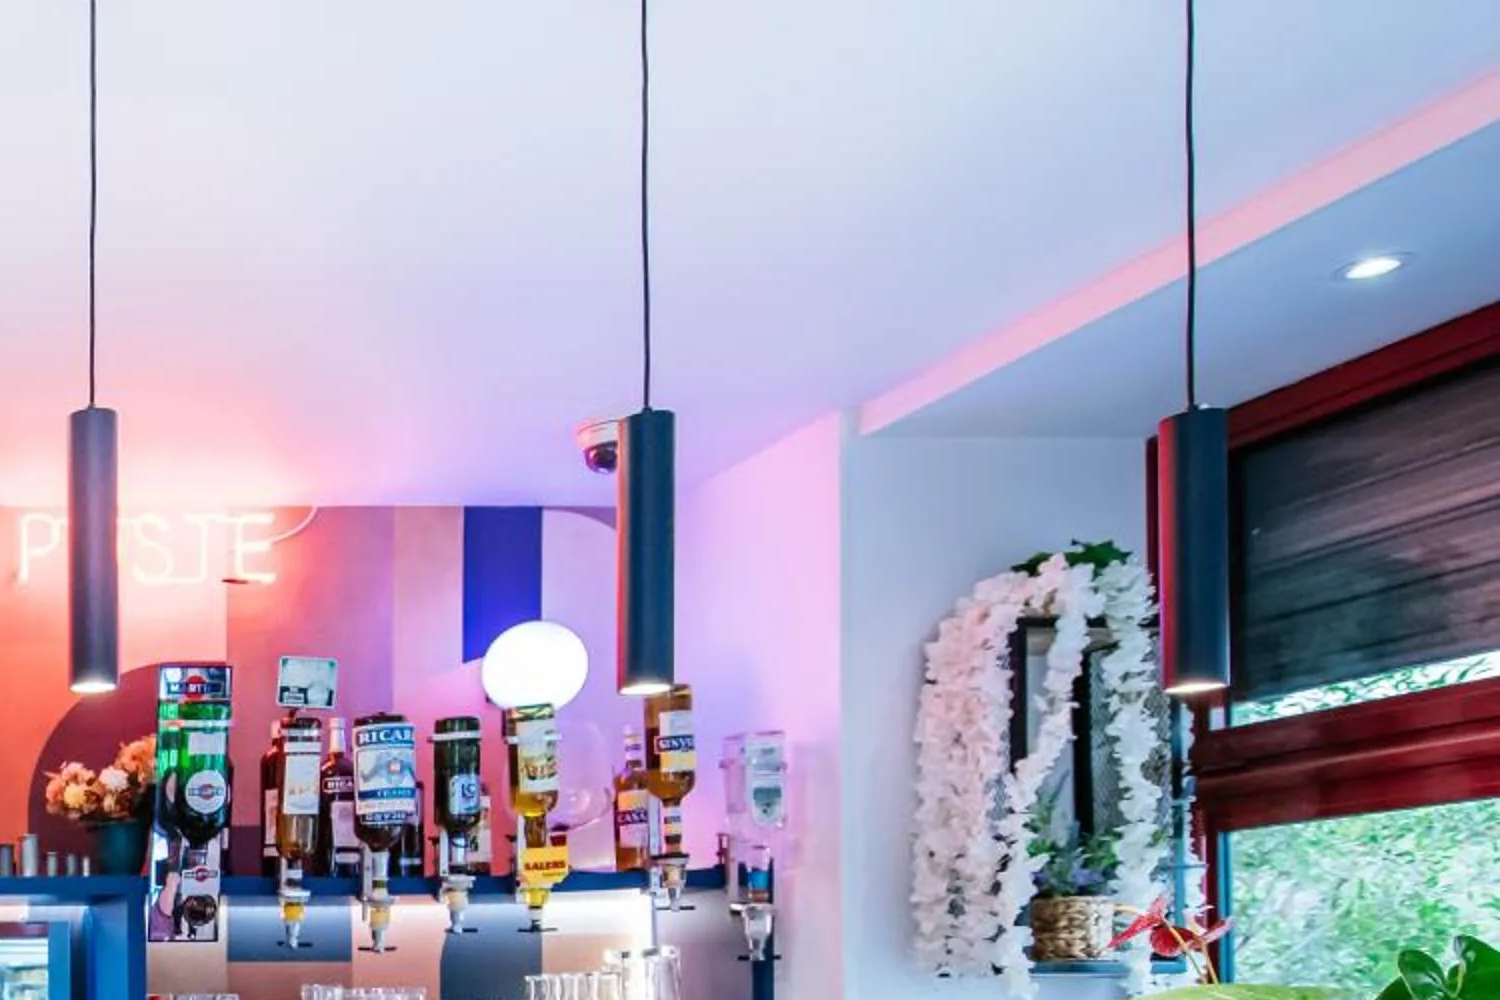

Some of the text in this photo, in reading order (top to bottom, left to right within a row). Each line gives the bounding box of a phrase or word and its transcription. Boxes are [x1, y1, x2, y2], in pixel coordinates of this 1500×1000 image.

[17, 512, 277, 585] PSTE
[358, 728, 414, 744] RICAR
[524, 860, 566, 871] SALERS
